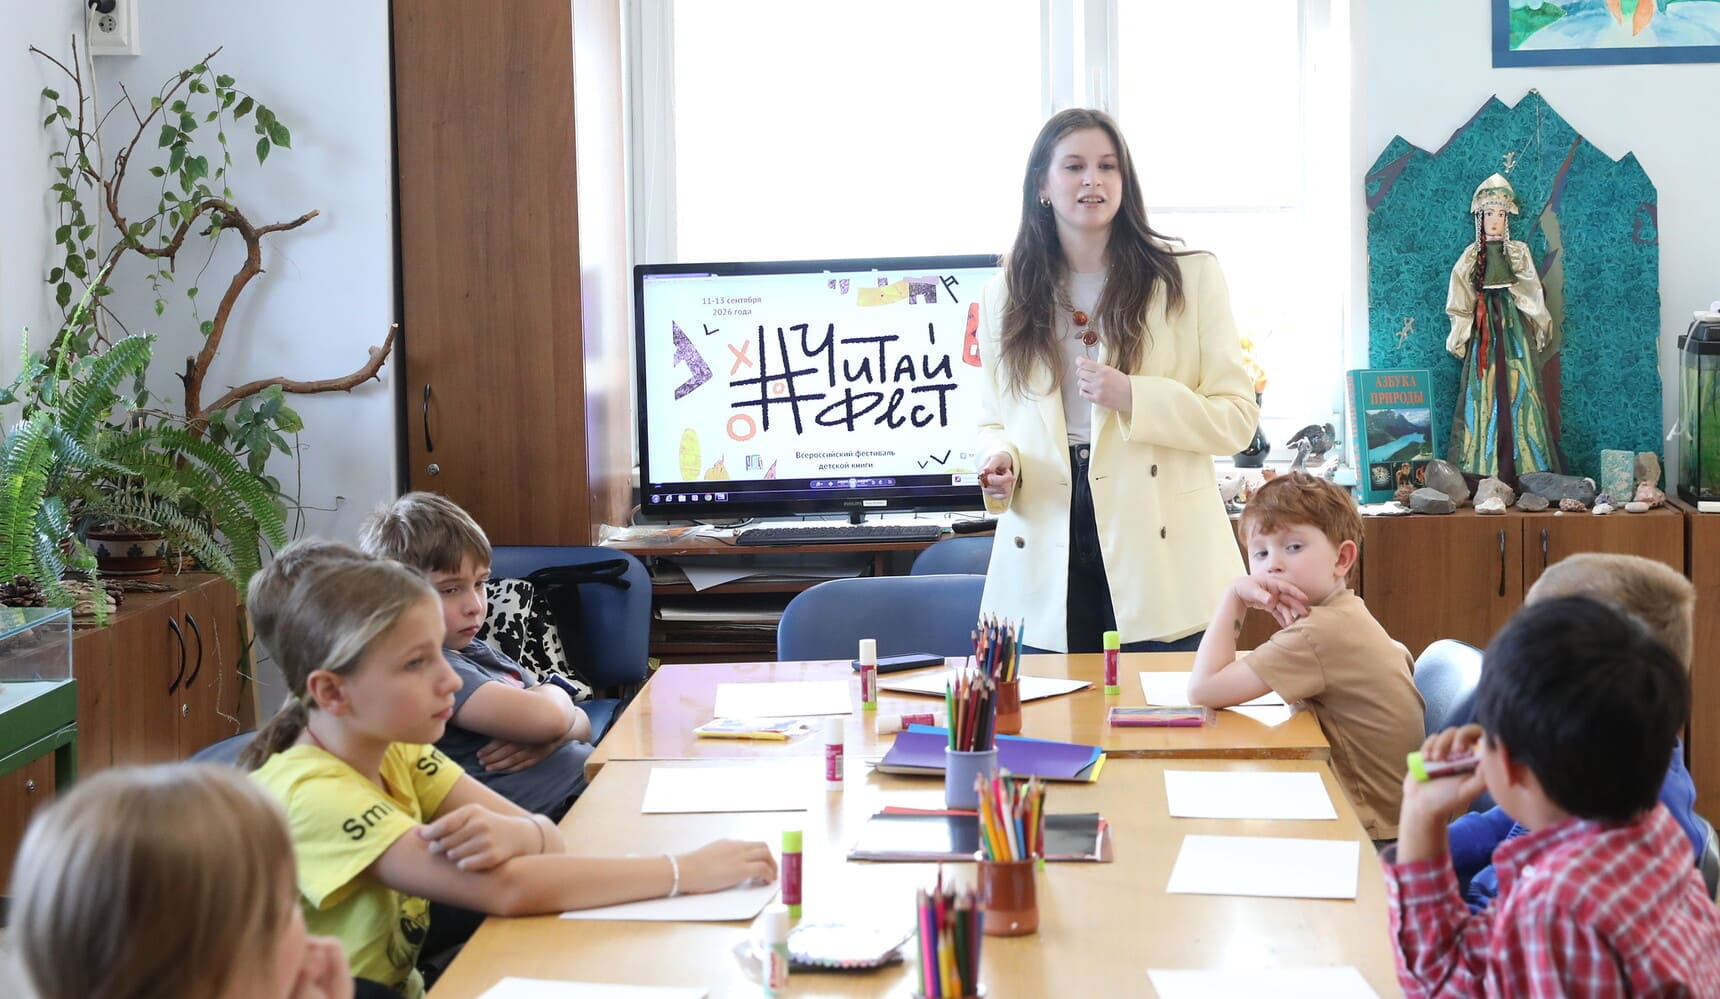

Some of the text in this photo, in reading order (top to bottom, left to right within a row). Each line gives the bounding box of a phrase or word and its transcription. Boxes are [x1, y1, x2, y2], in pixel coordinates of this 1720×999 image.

[726, 295, 762, 305] сентября
[712, 308, 752, 317] 2026 года
[1376, 375, 1417, 388] АЗБУКА
[1371, 391, 1425, 405] ПРИРОДЫ
[795, 449, 896, 459] Всероссийский фестиваль
[818, 461, 874, 470] детской книги
